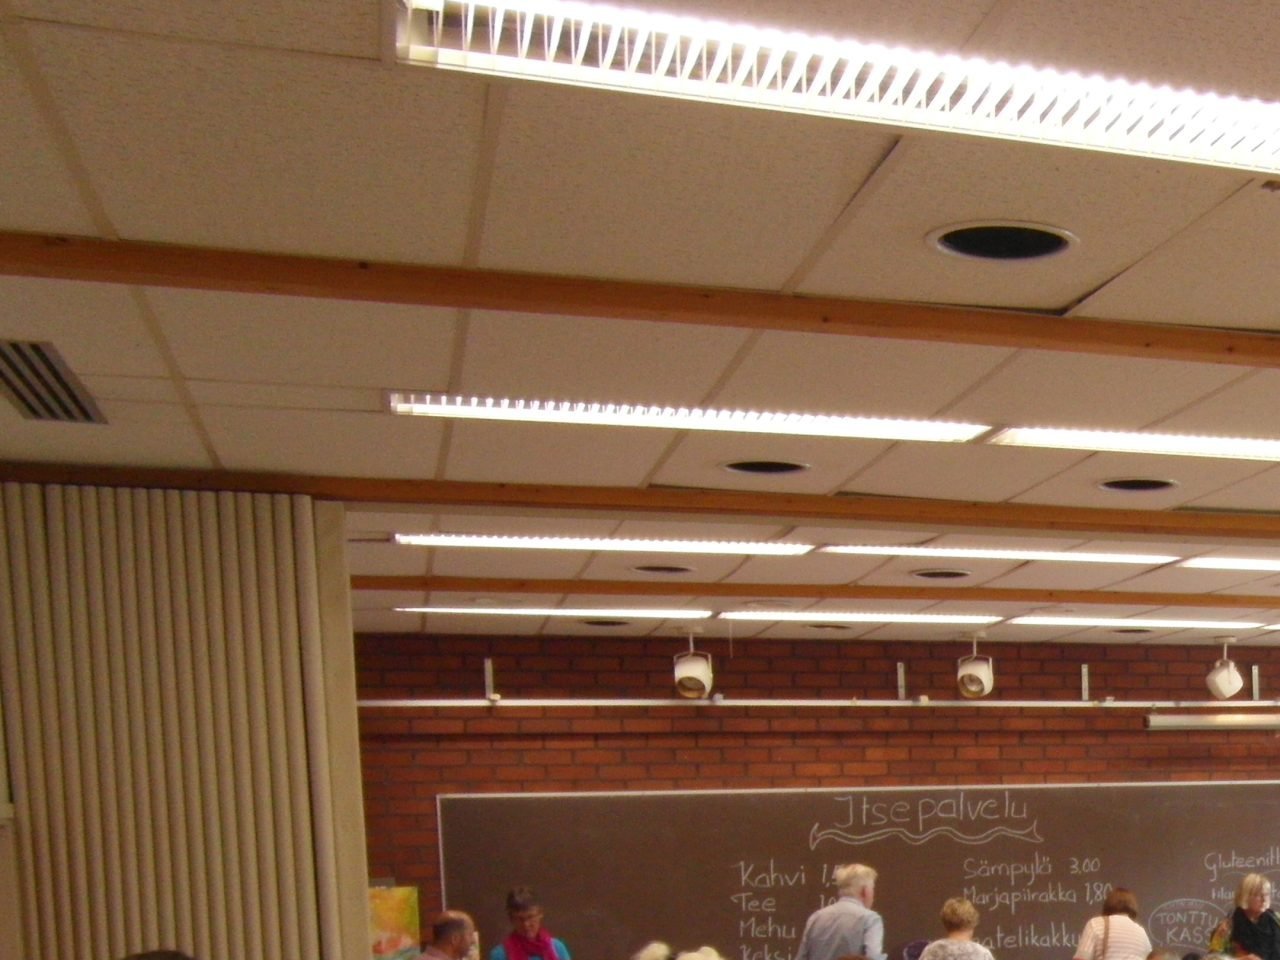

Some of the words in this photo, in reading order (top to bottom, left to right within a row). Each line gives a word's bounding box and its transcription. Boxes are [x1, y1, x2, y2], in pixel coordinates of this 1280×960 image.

[731, 858, 805, 888] Kahvi
[963, 851, 1052, 886] Sämpylä
[731, 892, 777, 912] Tee
[740, 917, 796, 938] Mehu
